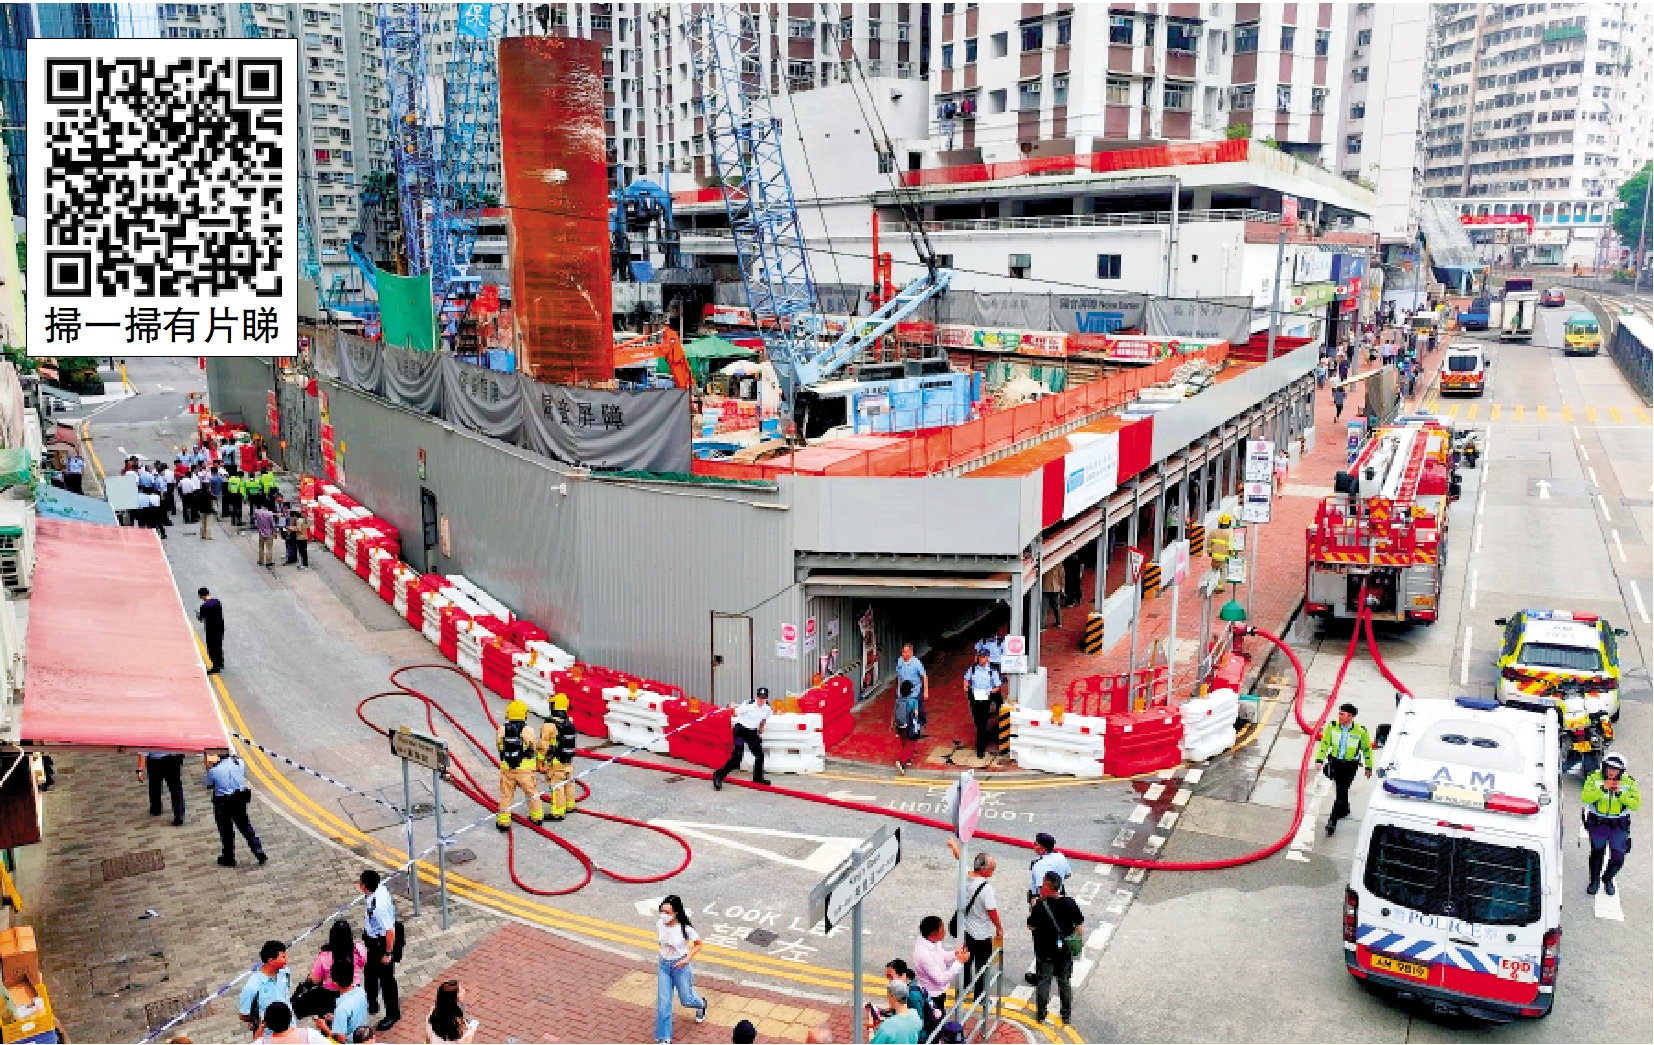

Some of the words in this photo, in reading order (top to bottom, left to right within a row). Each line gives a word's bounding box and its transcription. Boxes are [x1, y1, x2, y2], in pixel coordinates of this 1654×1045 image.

[702, 900, 782, 926] LOOK
[1408, 911, 1482, 938] POLICE
[1502, 959, 1531, 973] EOD
